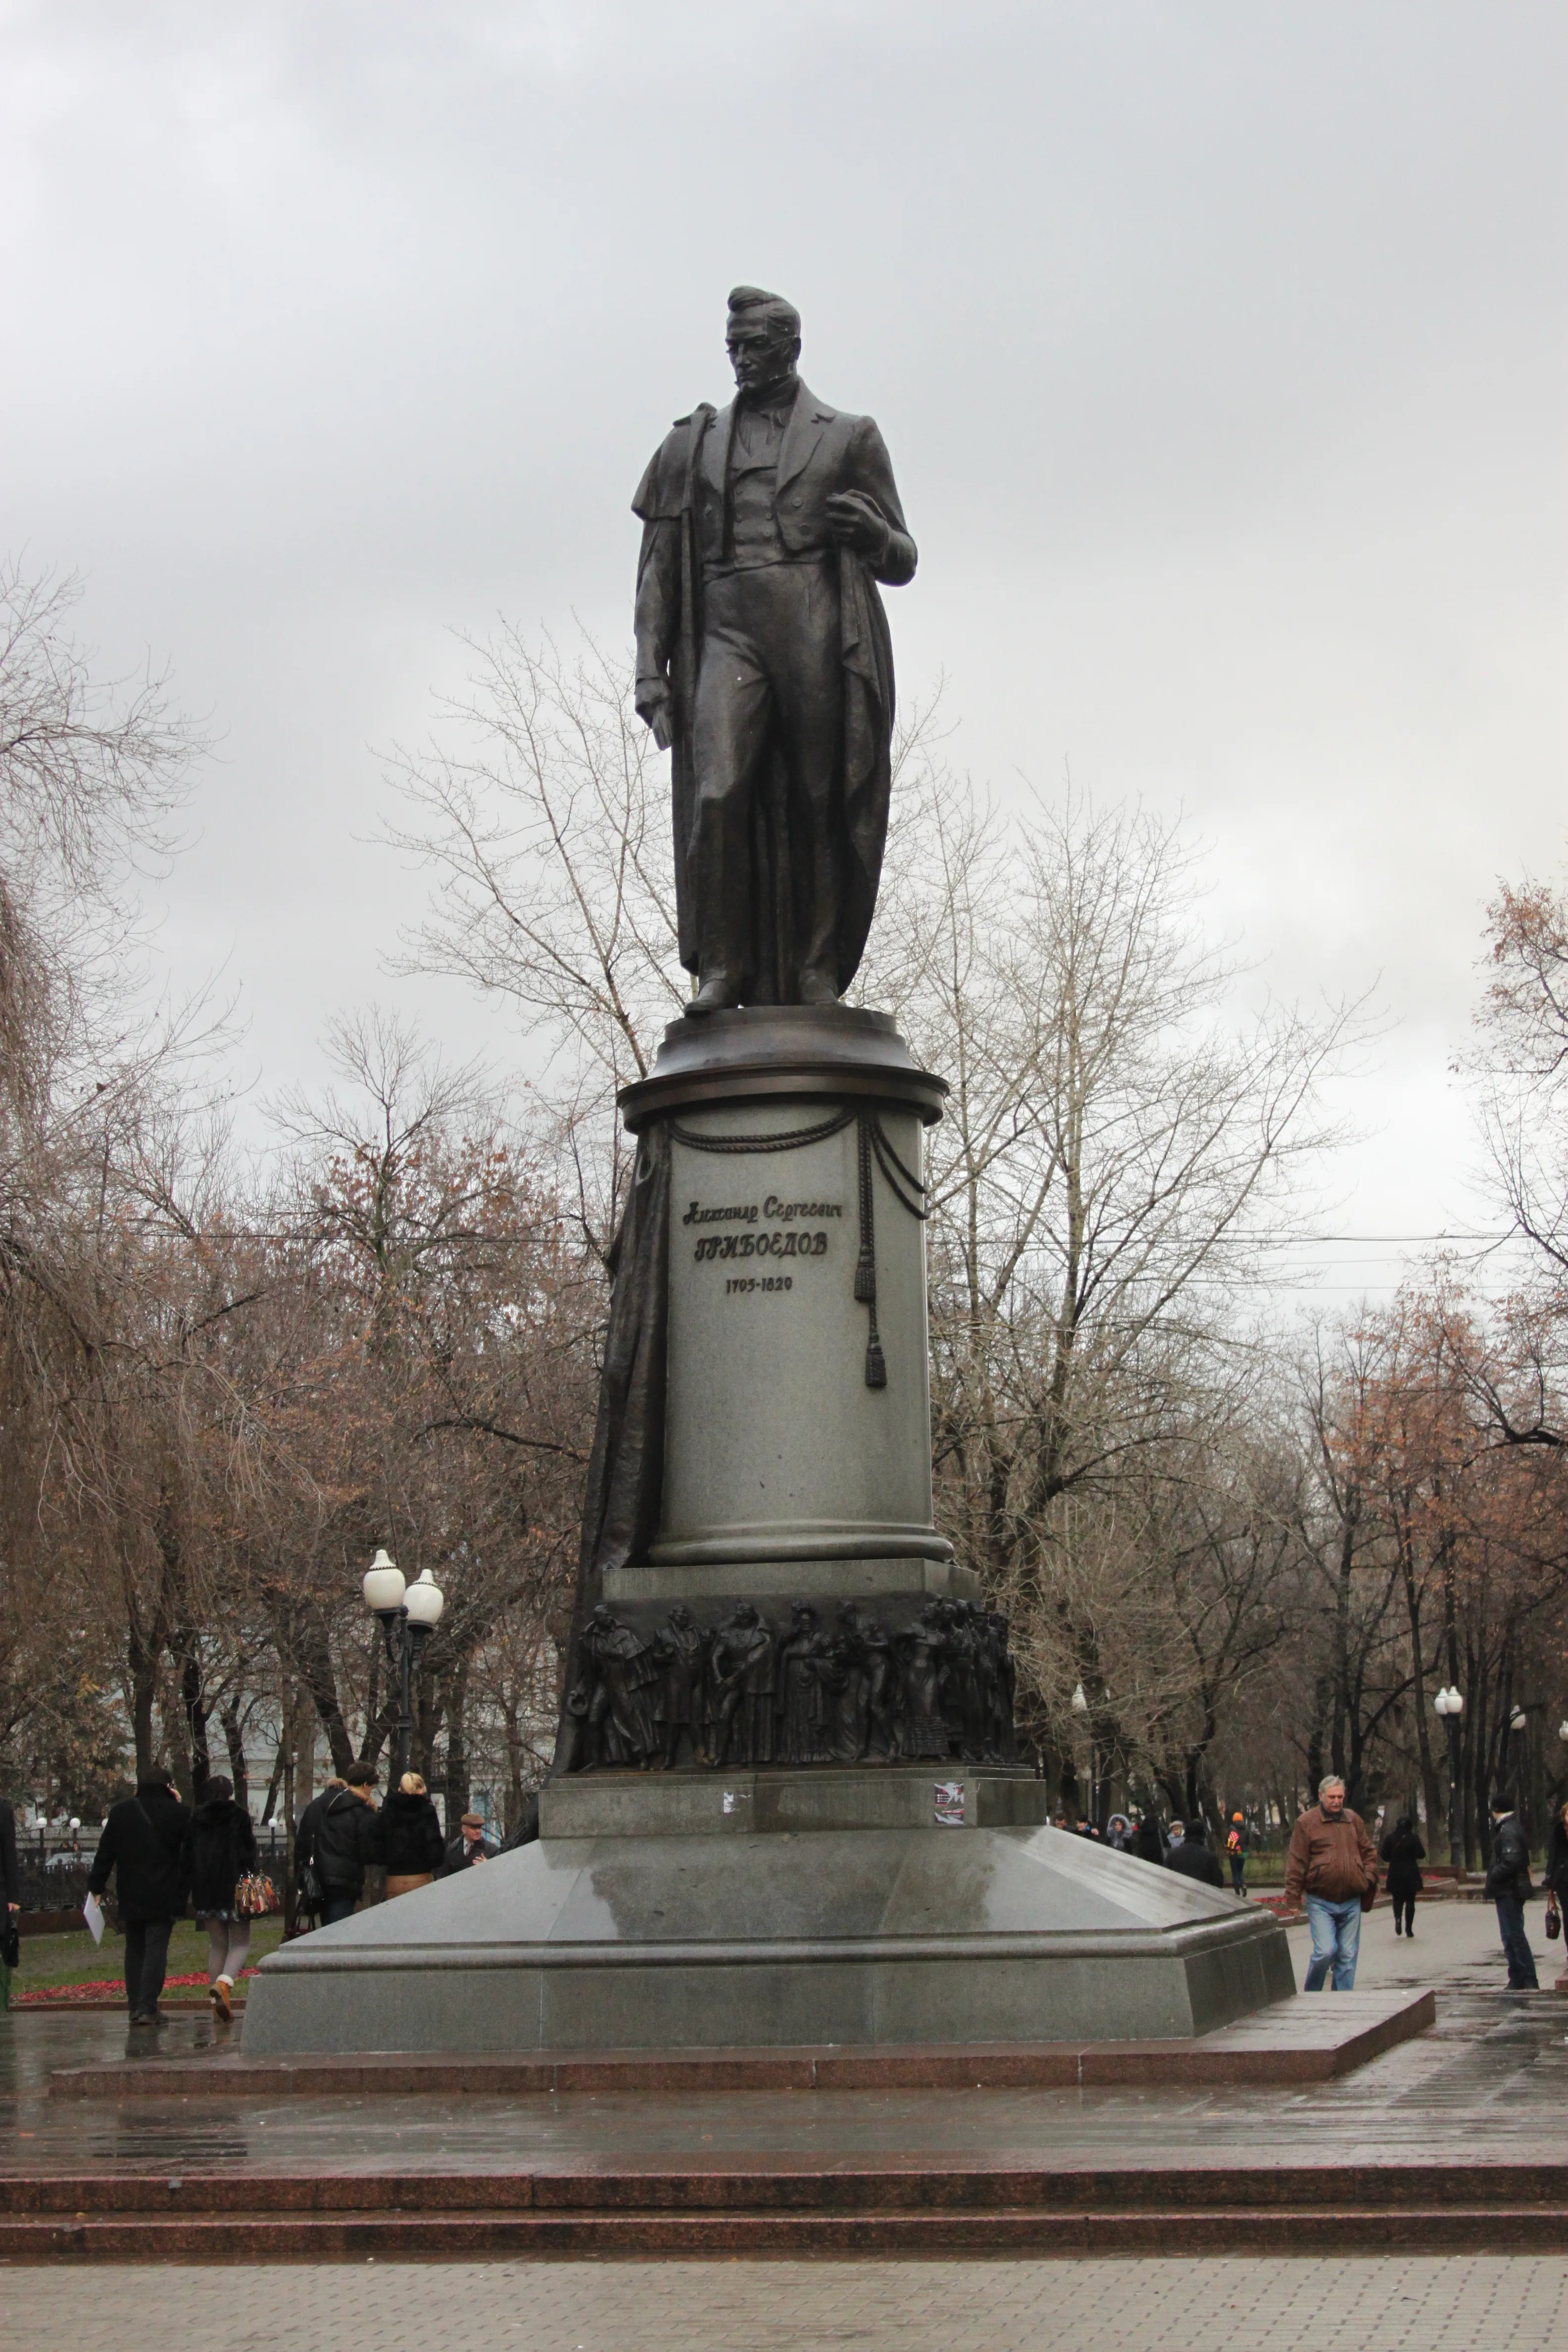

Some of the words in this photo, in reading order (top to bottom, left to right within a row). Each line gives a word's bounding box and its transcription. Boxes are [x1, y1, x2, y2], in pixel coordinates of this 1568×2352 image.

[682, 1201, 758, 1225] Александр
[763, 1195, 843, 1222] Сергеевич
[694, 1231, 828, 1261] ГРИБОЕДОВ
